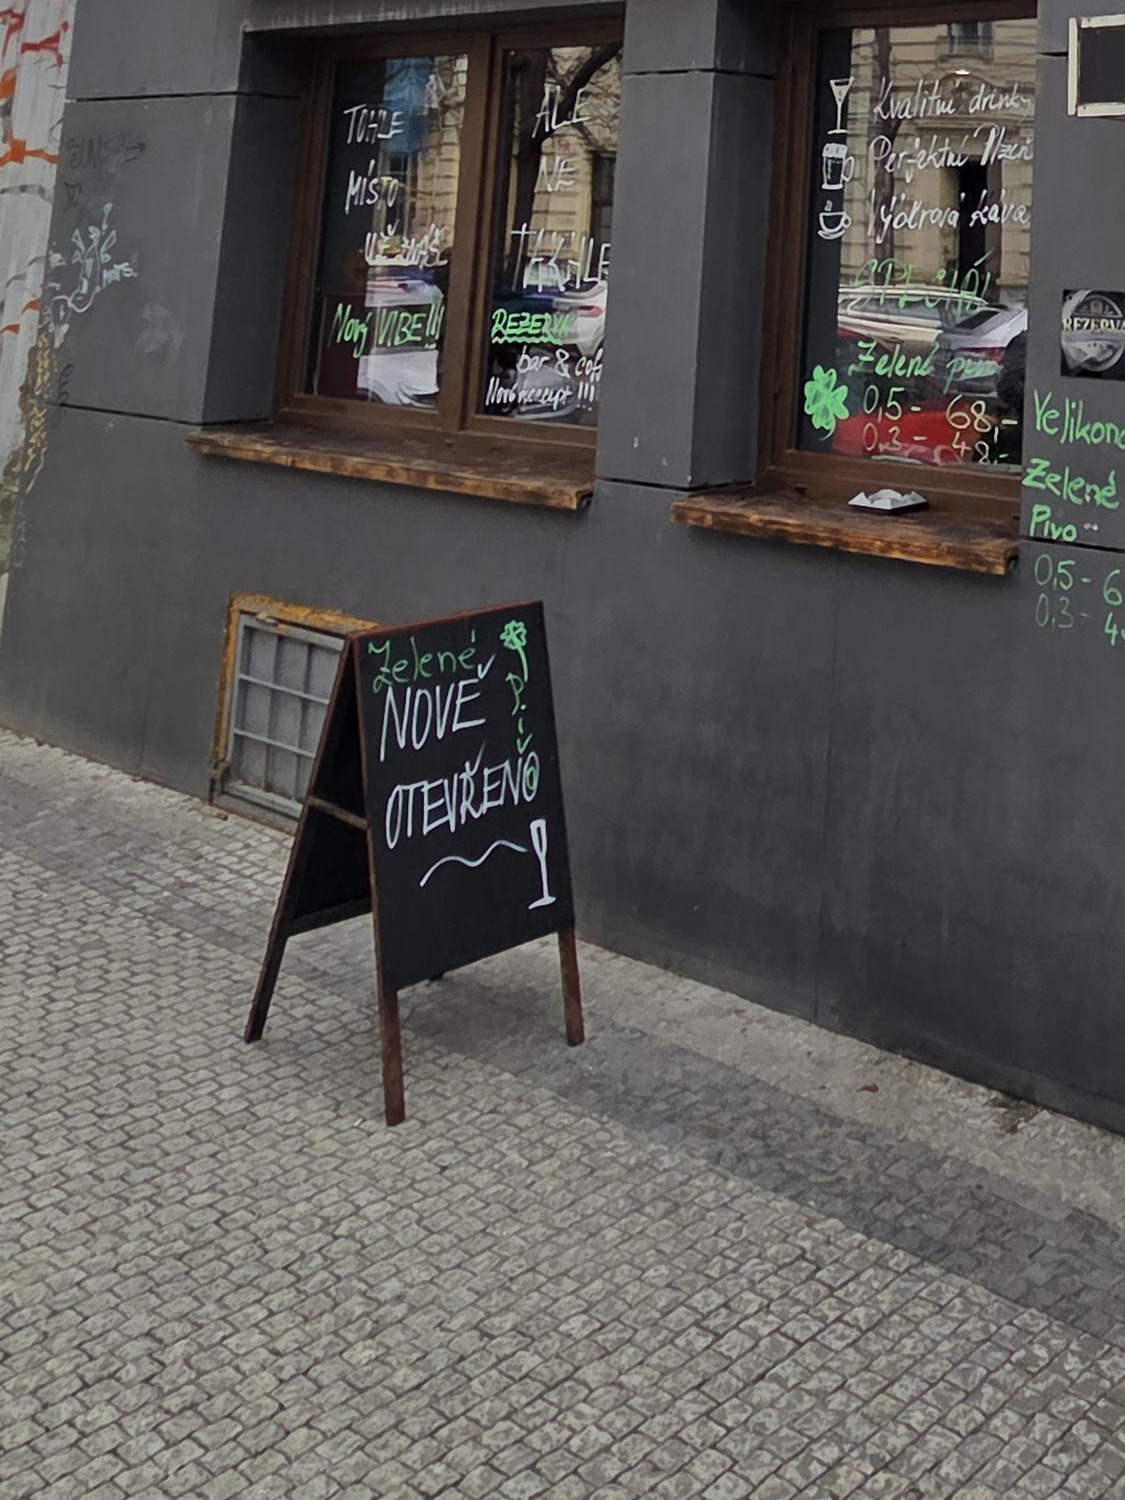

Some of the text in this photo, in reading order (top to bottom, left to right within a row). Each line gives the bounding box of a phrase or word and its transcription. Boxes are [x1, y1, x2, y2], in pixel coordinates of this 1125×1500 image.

[343, 103, 405, 144] TOHLE
[531, 83, 591, 139] ALE
[345, 158, 401, 215] MÍSTO
[534, 155, 578, 192] NE
[516, 345, 551, 374] bar
[554, 348, 571, 379] &
[1021, 457, 1120, 509] Zelené
[368, 628, 477, 694] Zelené
[385, 742, 541, 850] OTEVŘENO
